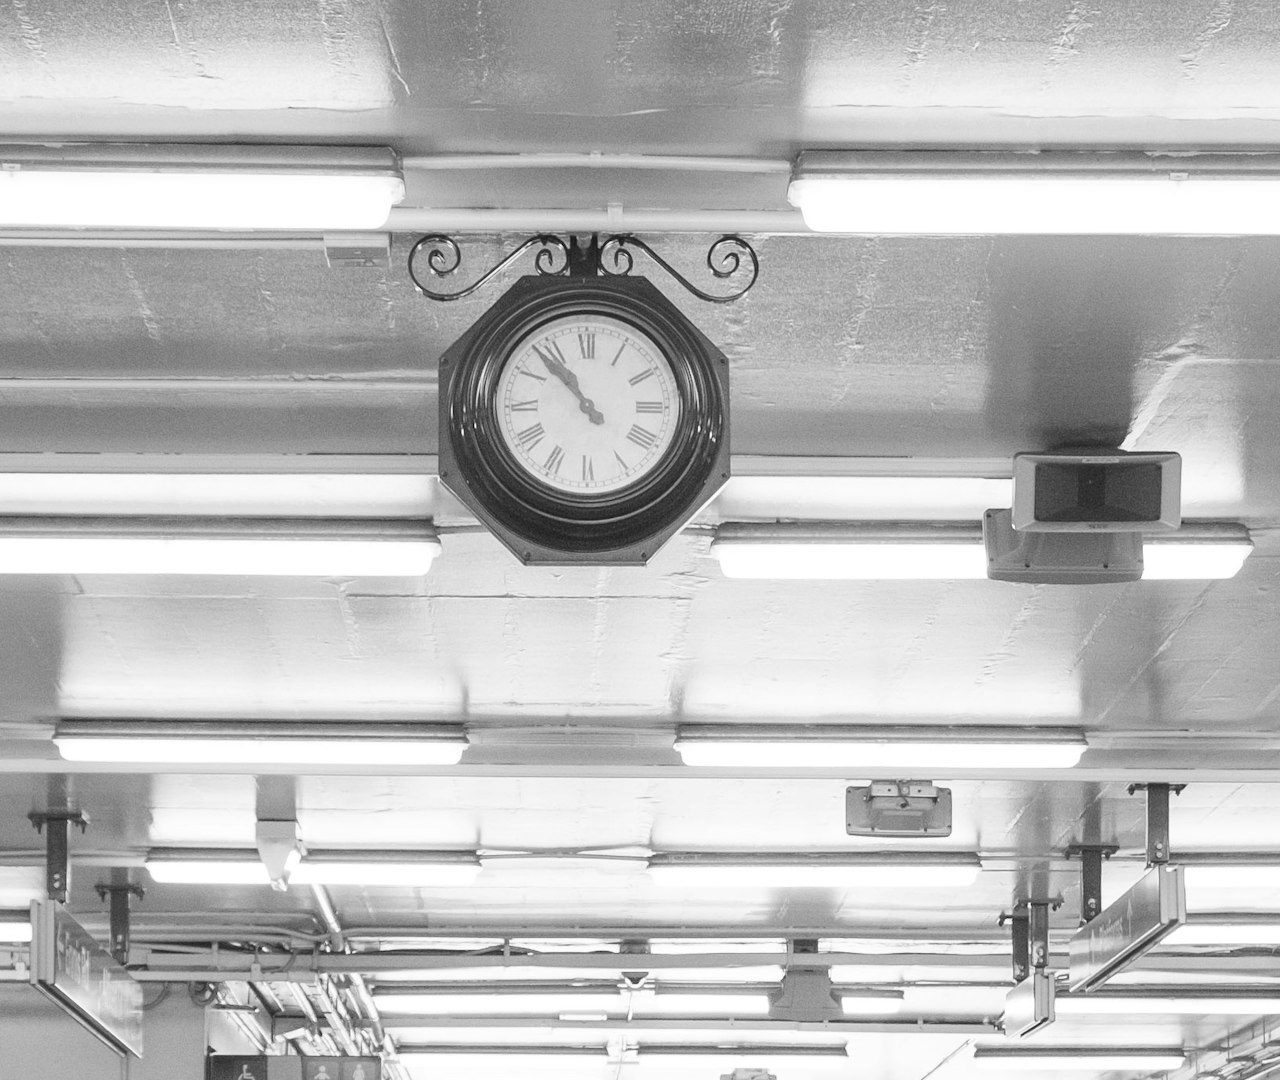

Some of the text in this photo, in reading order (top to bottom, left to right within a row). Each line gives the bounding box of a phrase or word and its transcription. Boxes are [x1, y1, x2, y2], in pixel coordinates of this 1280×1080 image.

[577, 333, 596, 360] XII
[628, 368, 655, 387] II
[635, 401, 664, 414] III
[517, 422, 547, 453] VIII
[543, 445, 566, 475] VII
[581, 454, 595, 482] VI
